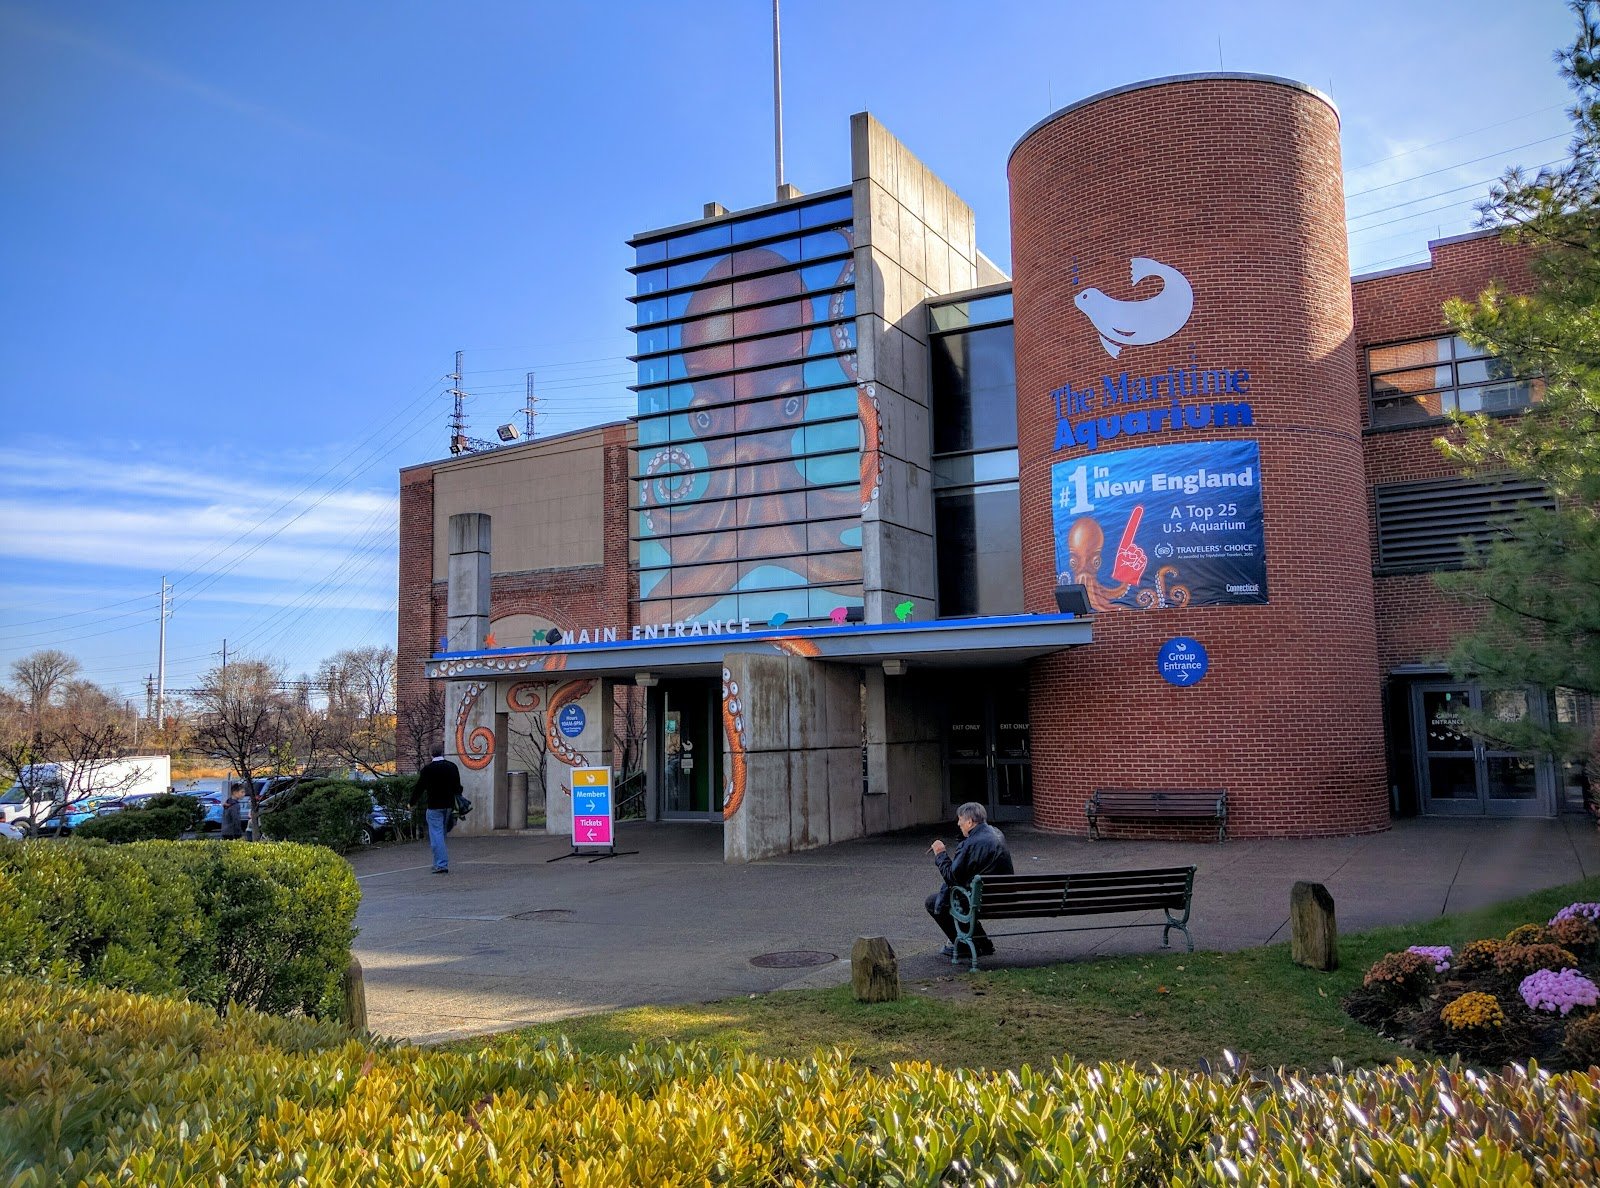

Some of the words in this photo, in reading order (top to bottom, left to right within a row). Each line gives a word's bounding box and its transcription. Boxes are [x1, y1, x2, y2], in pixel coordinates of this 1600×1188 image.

[1051, 383, 1094, 419] The
[1102, 365, 1249, 407] Maritime
[1053, 400, 1253, 450] Aquarium
[1060, 465, 1095, 515] #1
[1094, 466, 1109, 479] In
[1094, 480, 1146, 499] New
[1152, 467, 1253, 495] England
[1171, 507, 1182, 519] A
[1186, 505, 1213, 521] Top
[1218, 504, 1237, 517] 25
[1163, 523, 1186, 533] U.S.
[1190, 520, 1246, 534] Aquarium
[1226, 583, 1260, 592] Connecticut
[561, 627, 617, 645] MAIN
[632, 618, 751, 641] ENTRANCE
[1168, 653, 1196, 662] Group
[1163, 662, 1202, 670] Entrance
[576, 790, 606, 798] Members
[580, 819, 603, 827] Tickets
